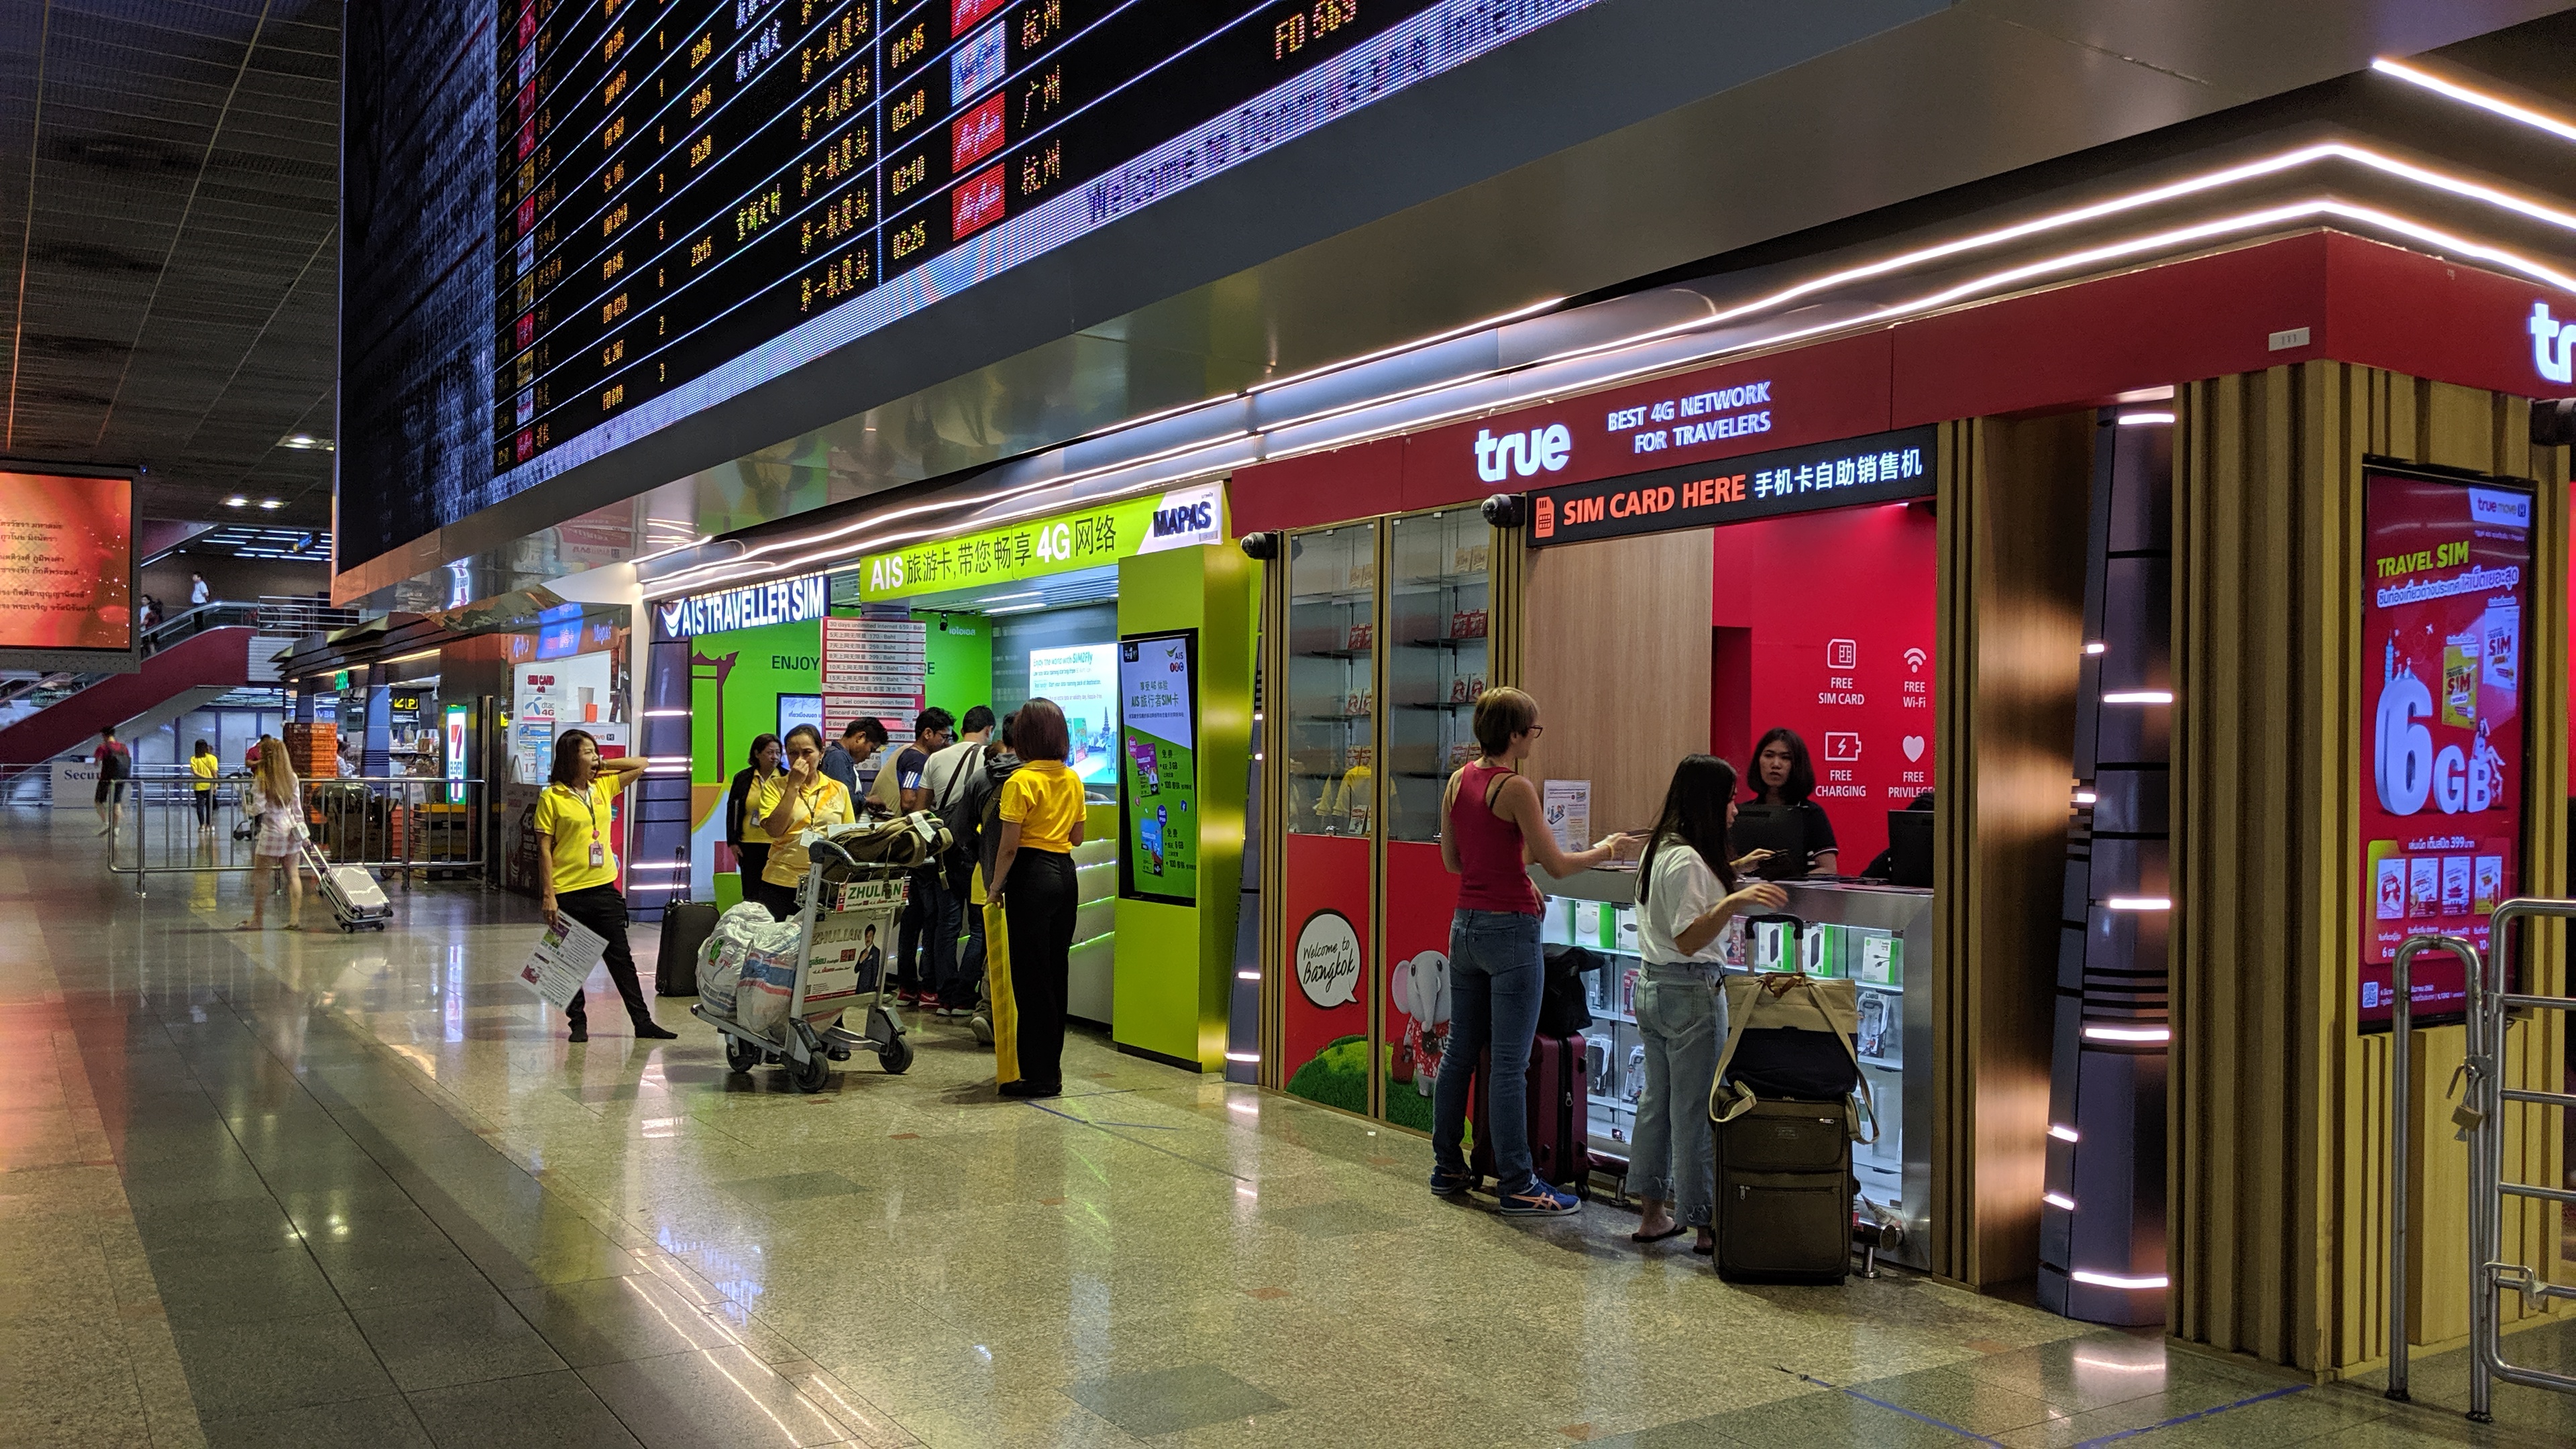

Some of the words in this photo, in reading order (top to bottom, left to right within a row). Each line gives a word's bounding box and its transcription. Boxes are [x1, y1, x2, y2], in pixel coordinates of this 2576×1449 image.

[1275, 12, 1305, 60] FD
[1086, 149, 1195, 223] Welcome
[1208, 131, 1228, 165] to
[1607, 406, 1648, 432] BEST
[1650, 401, 1675, 424] 4G
[1680, 381, 1771, 419] NETWORK
[1634, 429, 1668, 453] FOR
[1674, 411, 1771, 447] TRAVELERS
[1474, 423, 1571, 482] true
[1562, 494, 1605, 526] SIM
[1609, 486, 1675, 519] CARD
[1682, 474, 1746, 508] HERE
[1754, 448, 1923, 498] 手机卡自助销售机
[1152, 500, 1213, 538] MAPAS
[869, 555, 905, 592] AIS
[906, 530, 1032, 585] 旅游卡,带您畅享
[1036, 522, 1071, 564] 4G
[1075, 515, 1117, 557] 网络
[2376, 550, 2434, 578] TRAVEL
[2436, 541, 2469, 570] SIM
[682, 599, 705, 637] AIS
[706, 583, 790, 634] TRAVELLER
[792, 576, 825, 622] SIM
[1174, 652, 1184, 660] AIS
[2489, 635, 2512, 656] SIM
[771, 654, 820, 672] ENJOY
[1830, 676, 1853, 689] FREE
[1904, 681, 1925, 693] FREE
[2447, 672, 2471, 695] SIM
[541, 701, 555, 710] dtac
[1131, 695, 1140, 707] AIS
[1818, 692, 1836, 704] SIM
[1838, 693, 1865, 705] CARD
[1902, 696, 1926, 708] Wi-Fi
[541, 708, 555, 716] 4G
[1829, 769, 1852, 782] FREE
[1902, 771, 1924, 783] FREE
[1815, 785, 1867, 798] CHARGING
[1303, 941, 1338, 961] Welcome
[1342, 936, 1350, 951] to
[1303, 948, 1356, 993] Bangkok
